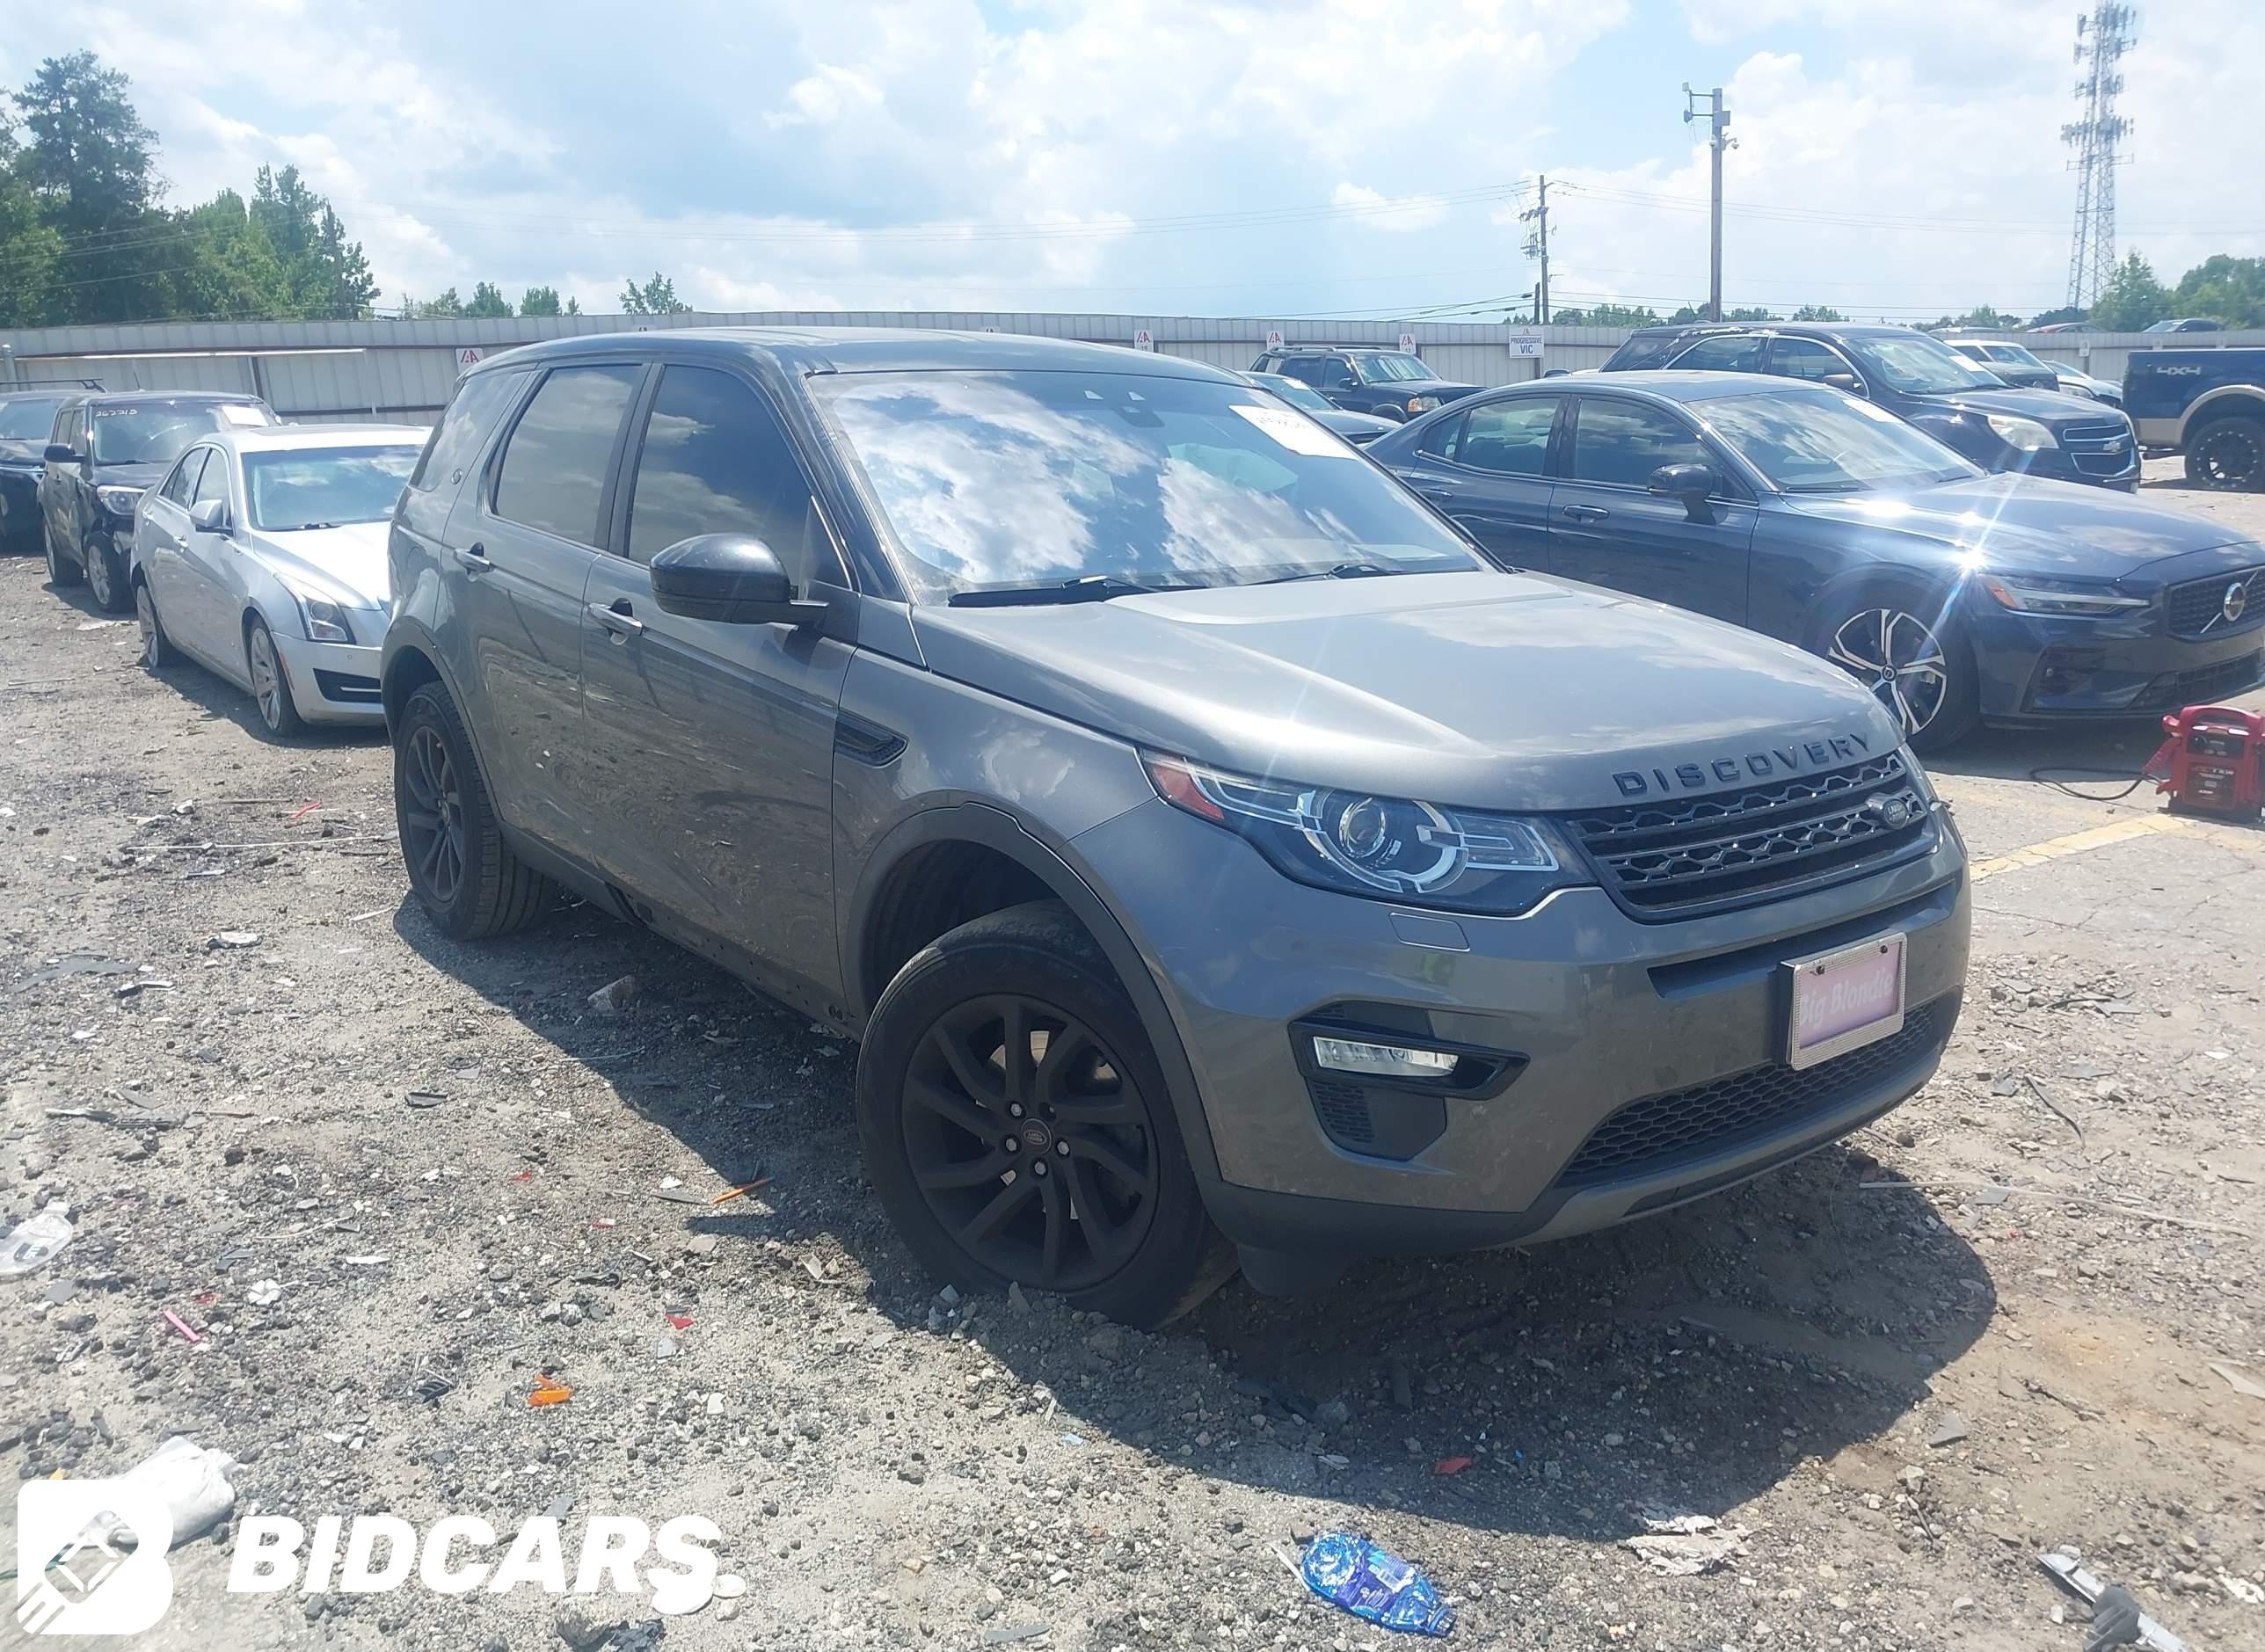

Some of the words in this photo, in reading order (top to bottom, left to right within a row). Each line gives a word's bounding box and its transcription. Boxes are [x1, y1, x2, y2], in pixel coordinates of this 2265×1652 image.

[1519, 344, 1533, 354] VIC
[1612, 731, 1871, 797] DISCOVERY
[1800, 990, 1826, 1030] Big
[1829, 968, 1893, 1015] Blondie
